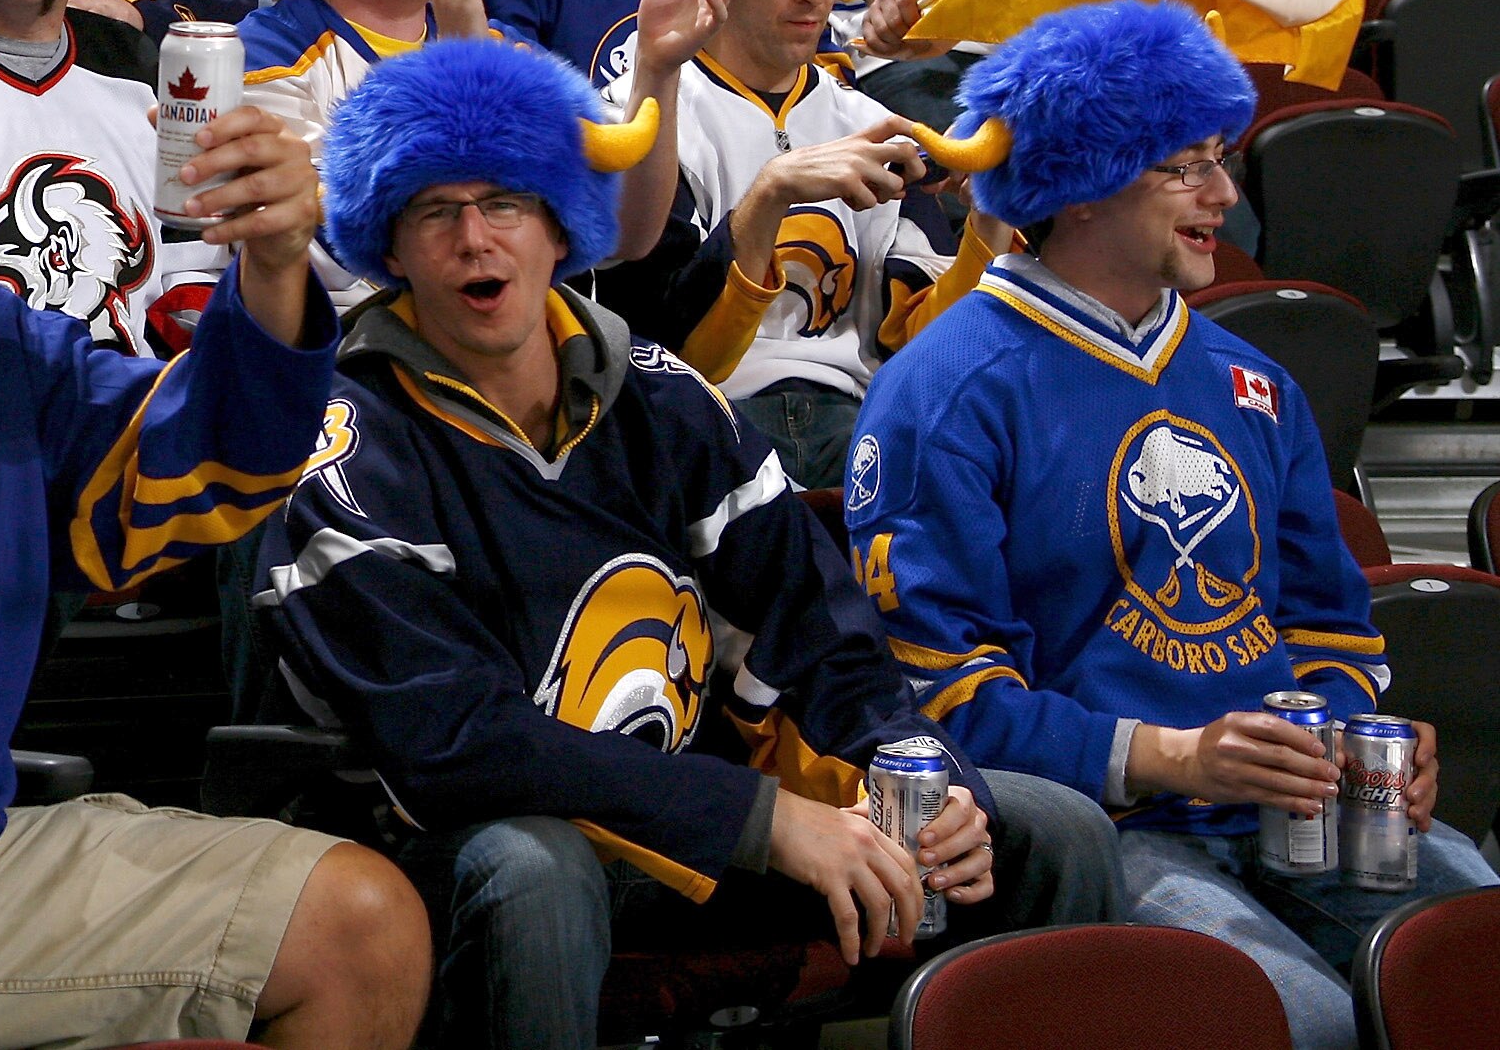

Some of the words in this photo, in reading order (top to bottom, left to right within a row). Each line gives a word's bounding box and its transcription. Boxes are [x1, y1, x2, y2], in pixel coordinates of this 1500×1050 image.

[160, 103, 217, 123] CANADIAN
[1103, 598, 1228, 674] CARBORO
[1226, 614, 1279, 666] SAB
[1345, 758, 1406, 790] Coors
